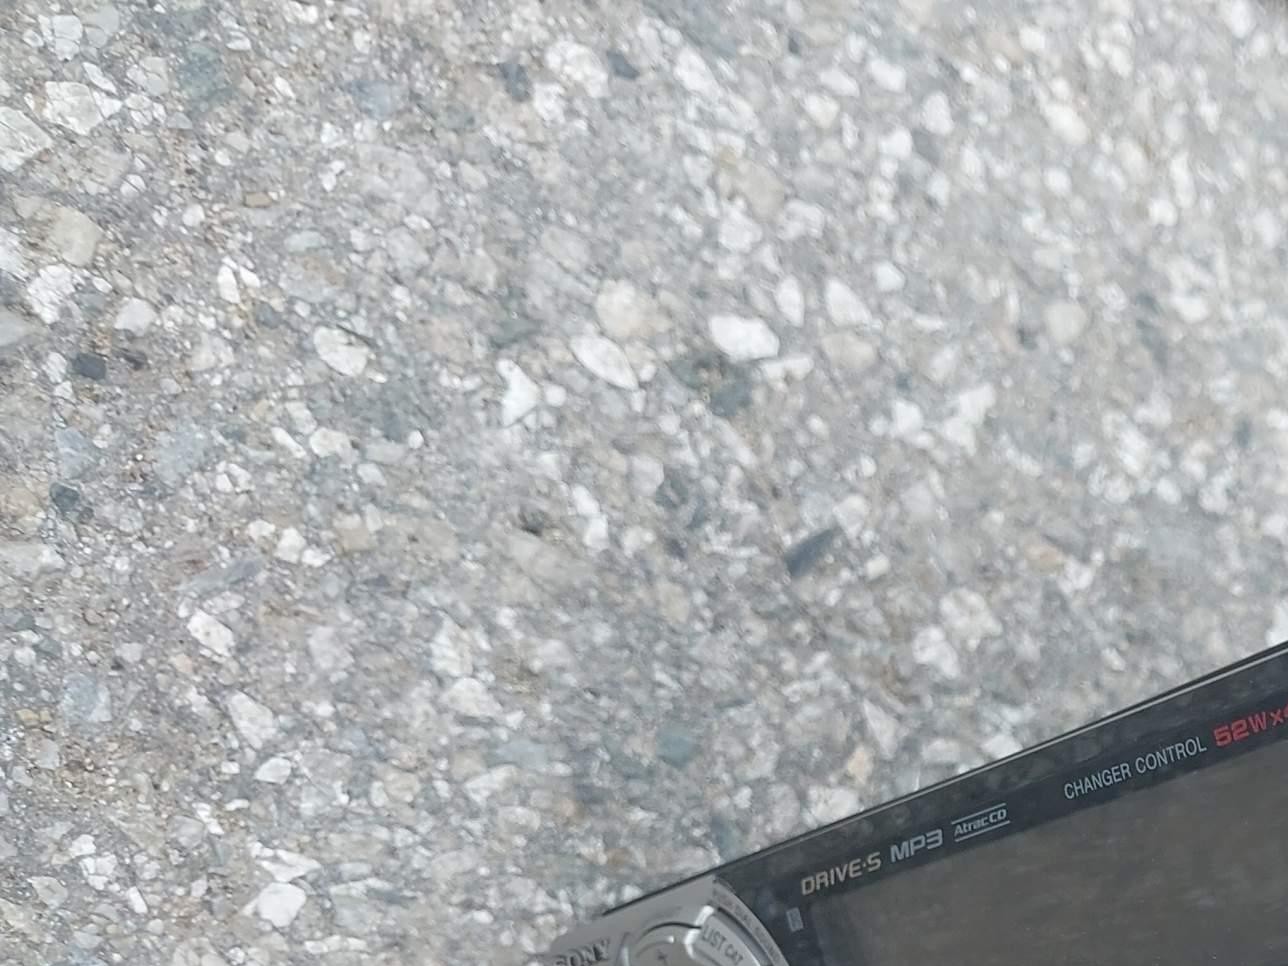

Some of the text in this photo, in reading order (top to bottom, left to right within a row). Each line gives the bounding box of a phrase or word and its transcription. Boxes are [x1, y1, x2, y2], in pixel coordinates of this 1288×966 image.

[1063, 735, 1207, 801] CHANGER CONTROL
[889, 829, 944, 863] MP3
